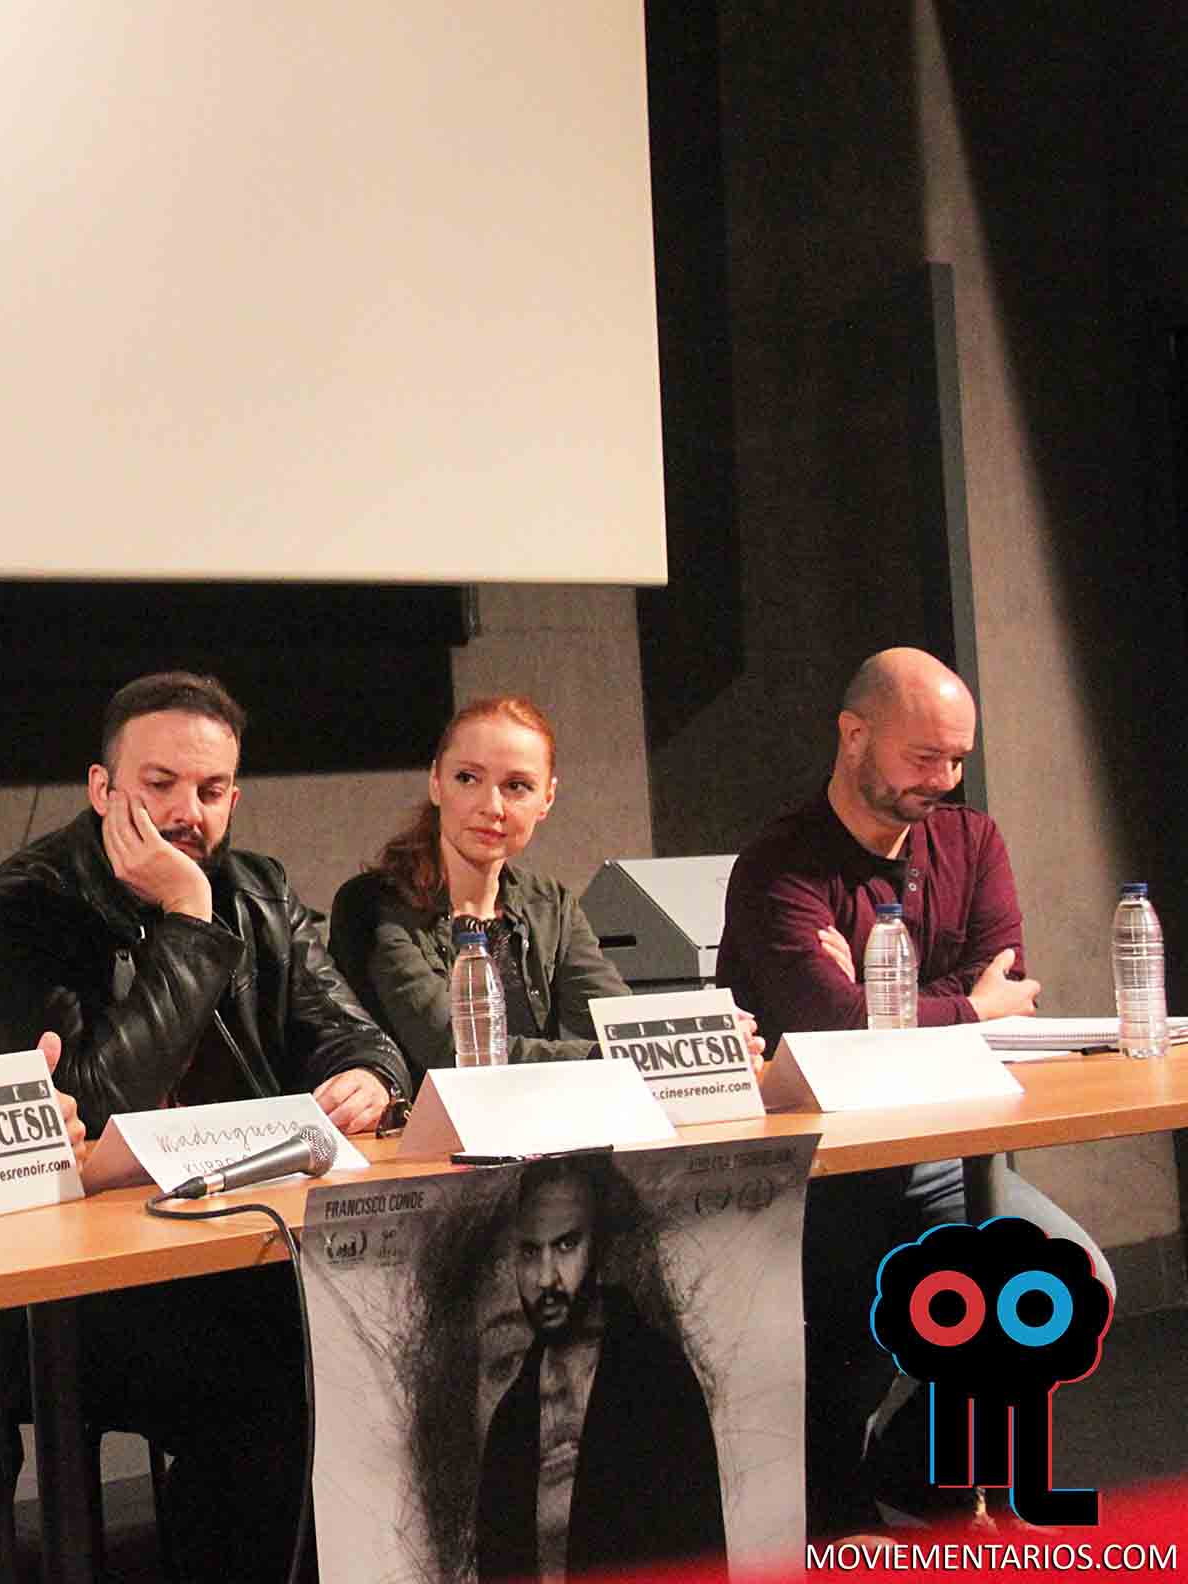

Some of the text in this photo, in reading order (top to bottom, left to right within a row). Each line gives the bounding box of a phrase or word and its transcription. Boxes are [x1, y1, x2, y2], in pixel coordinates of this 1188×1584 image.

[605, 1015, 733, 1039] CINES
[324, 1191, 426, 1219] FRANCISCO CONDE
